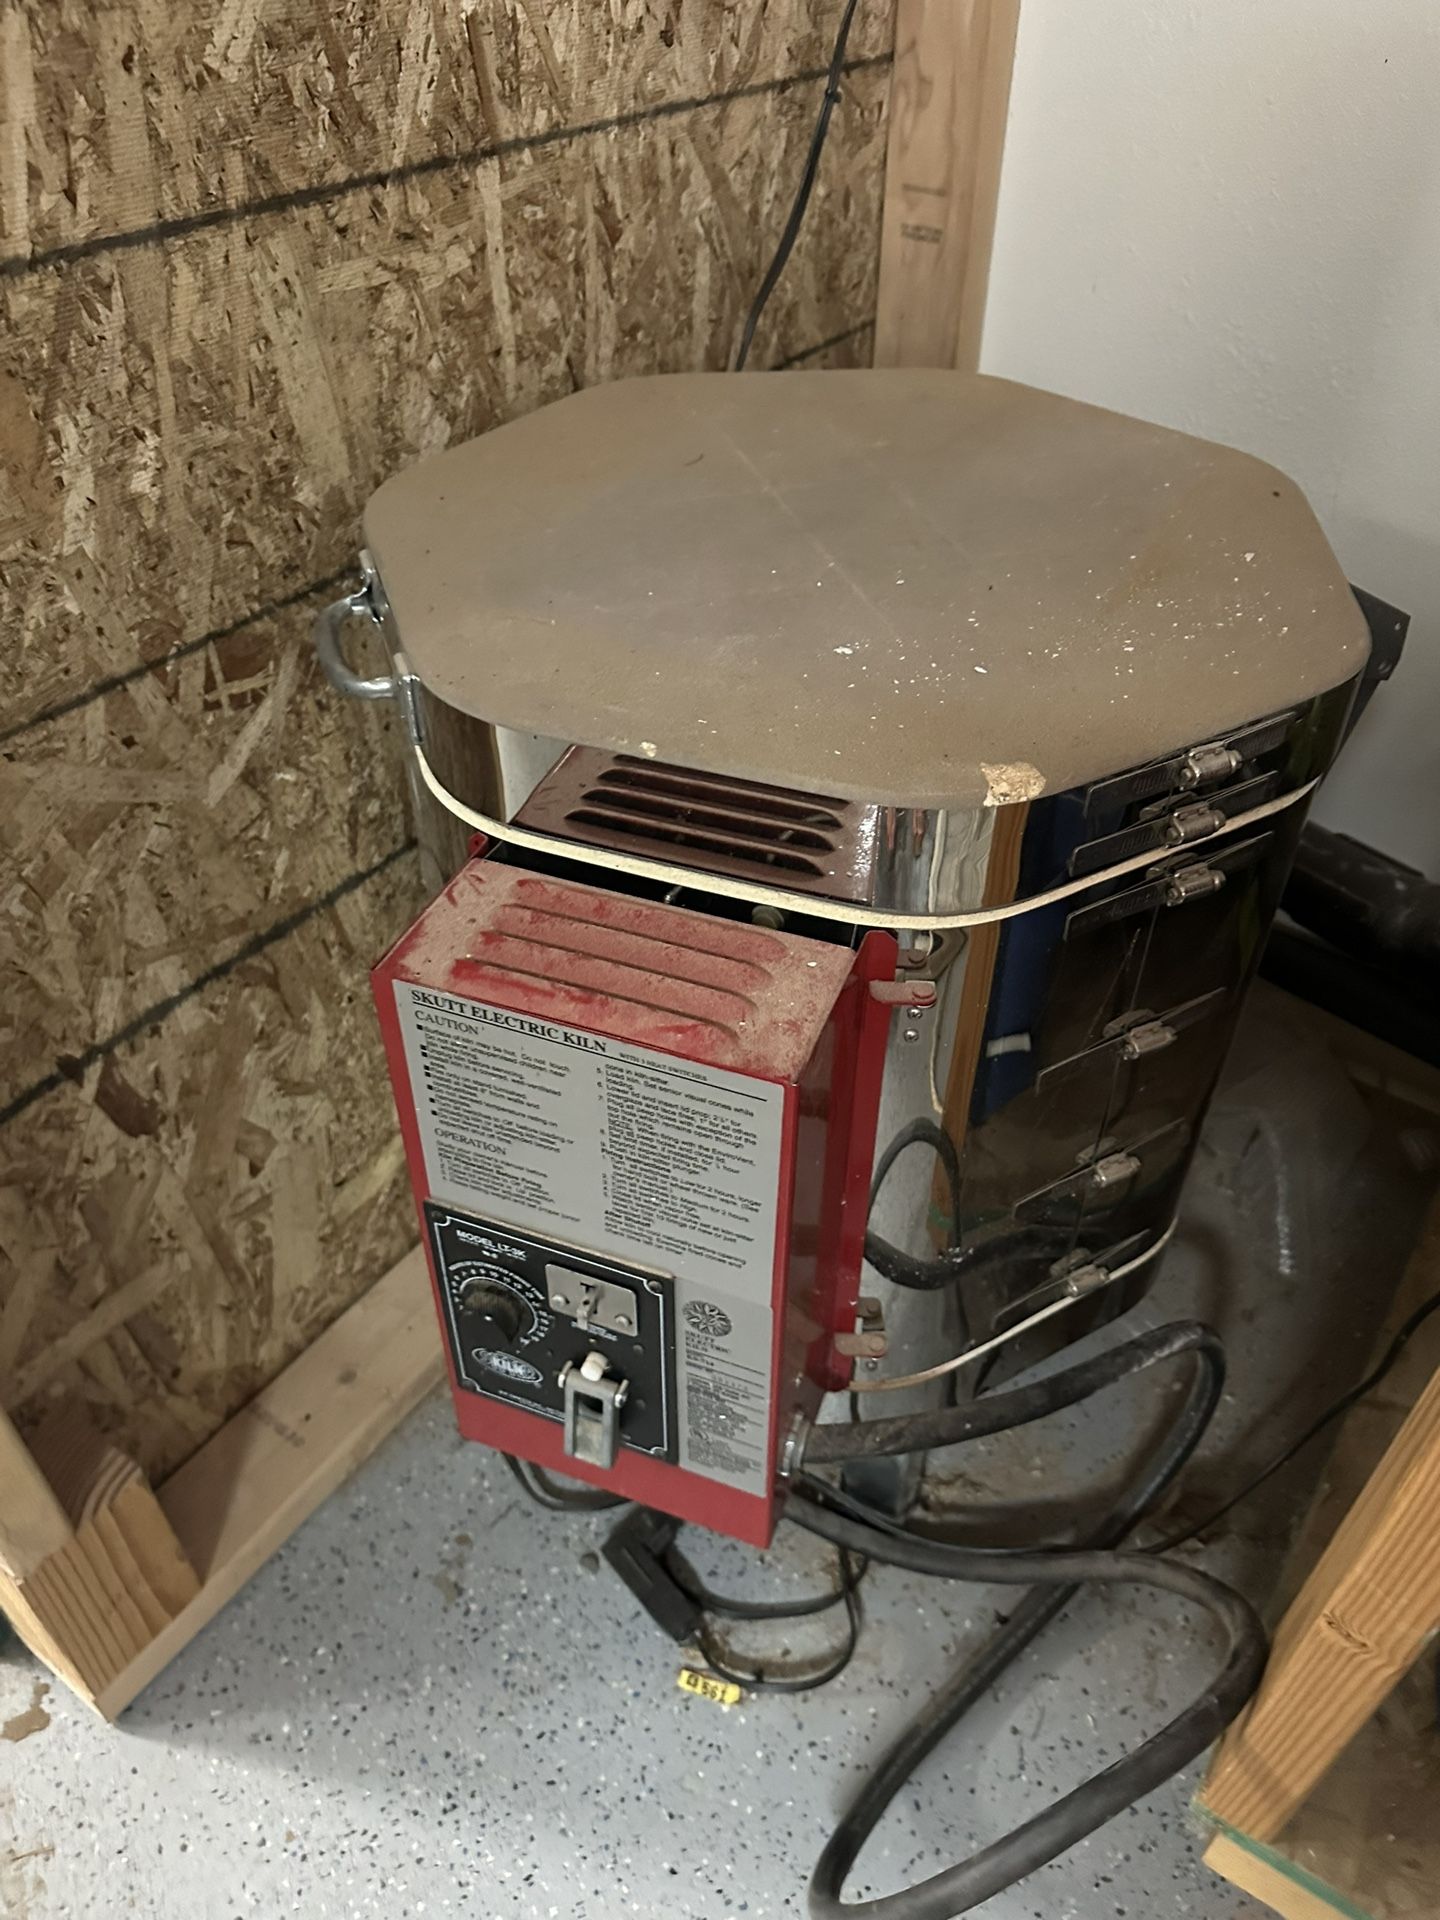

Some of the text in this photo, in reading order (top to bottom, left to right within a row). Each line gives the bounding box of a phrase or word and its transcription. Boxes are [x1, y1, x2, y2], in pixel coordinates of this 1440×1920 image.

[411, 989, 606, 1052] SKUTT ELECTRIC KILN
[414, 1010, 478, 1035] CAUTION
[434, 1127, 506, 1155] OPERATION
[456, 1229, 495, 1248] MODEL
